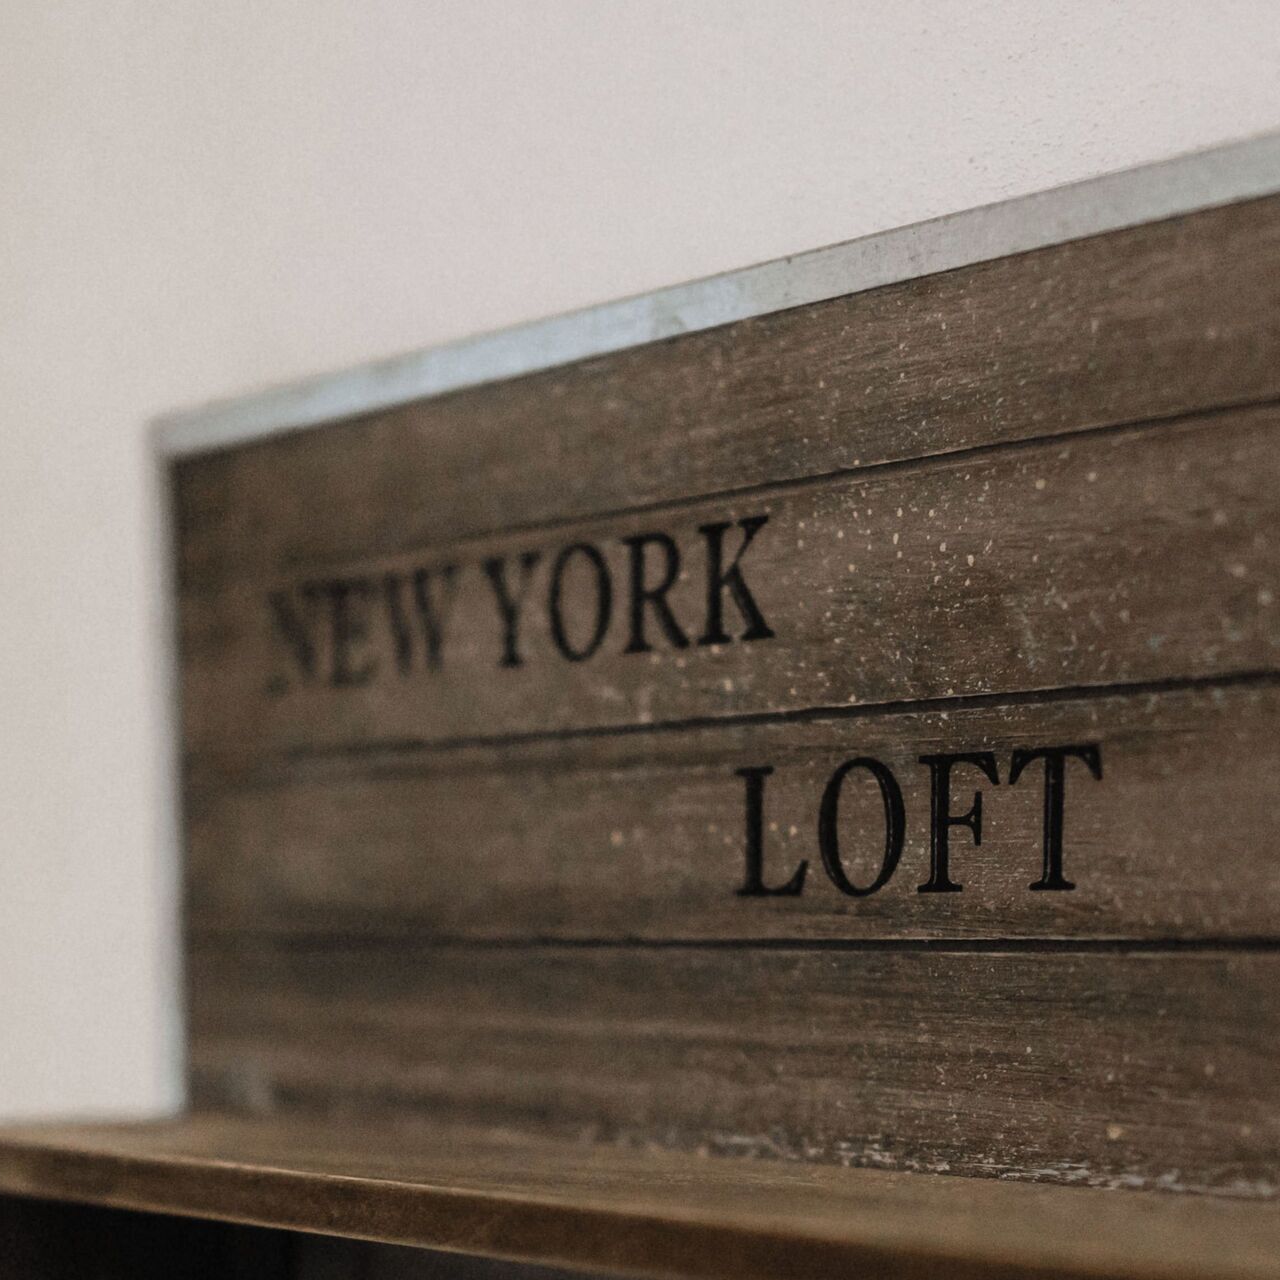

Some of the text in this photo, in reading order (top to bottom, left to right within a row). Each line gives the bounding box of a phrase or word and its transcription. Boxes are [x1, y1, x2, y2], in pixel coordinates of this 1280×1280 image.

[266, 514, 776, 696] NEW YORK
[732, 742, 1104, 898] LOFT
